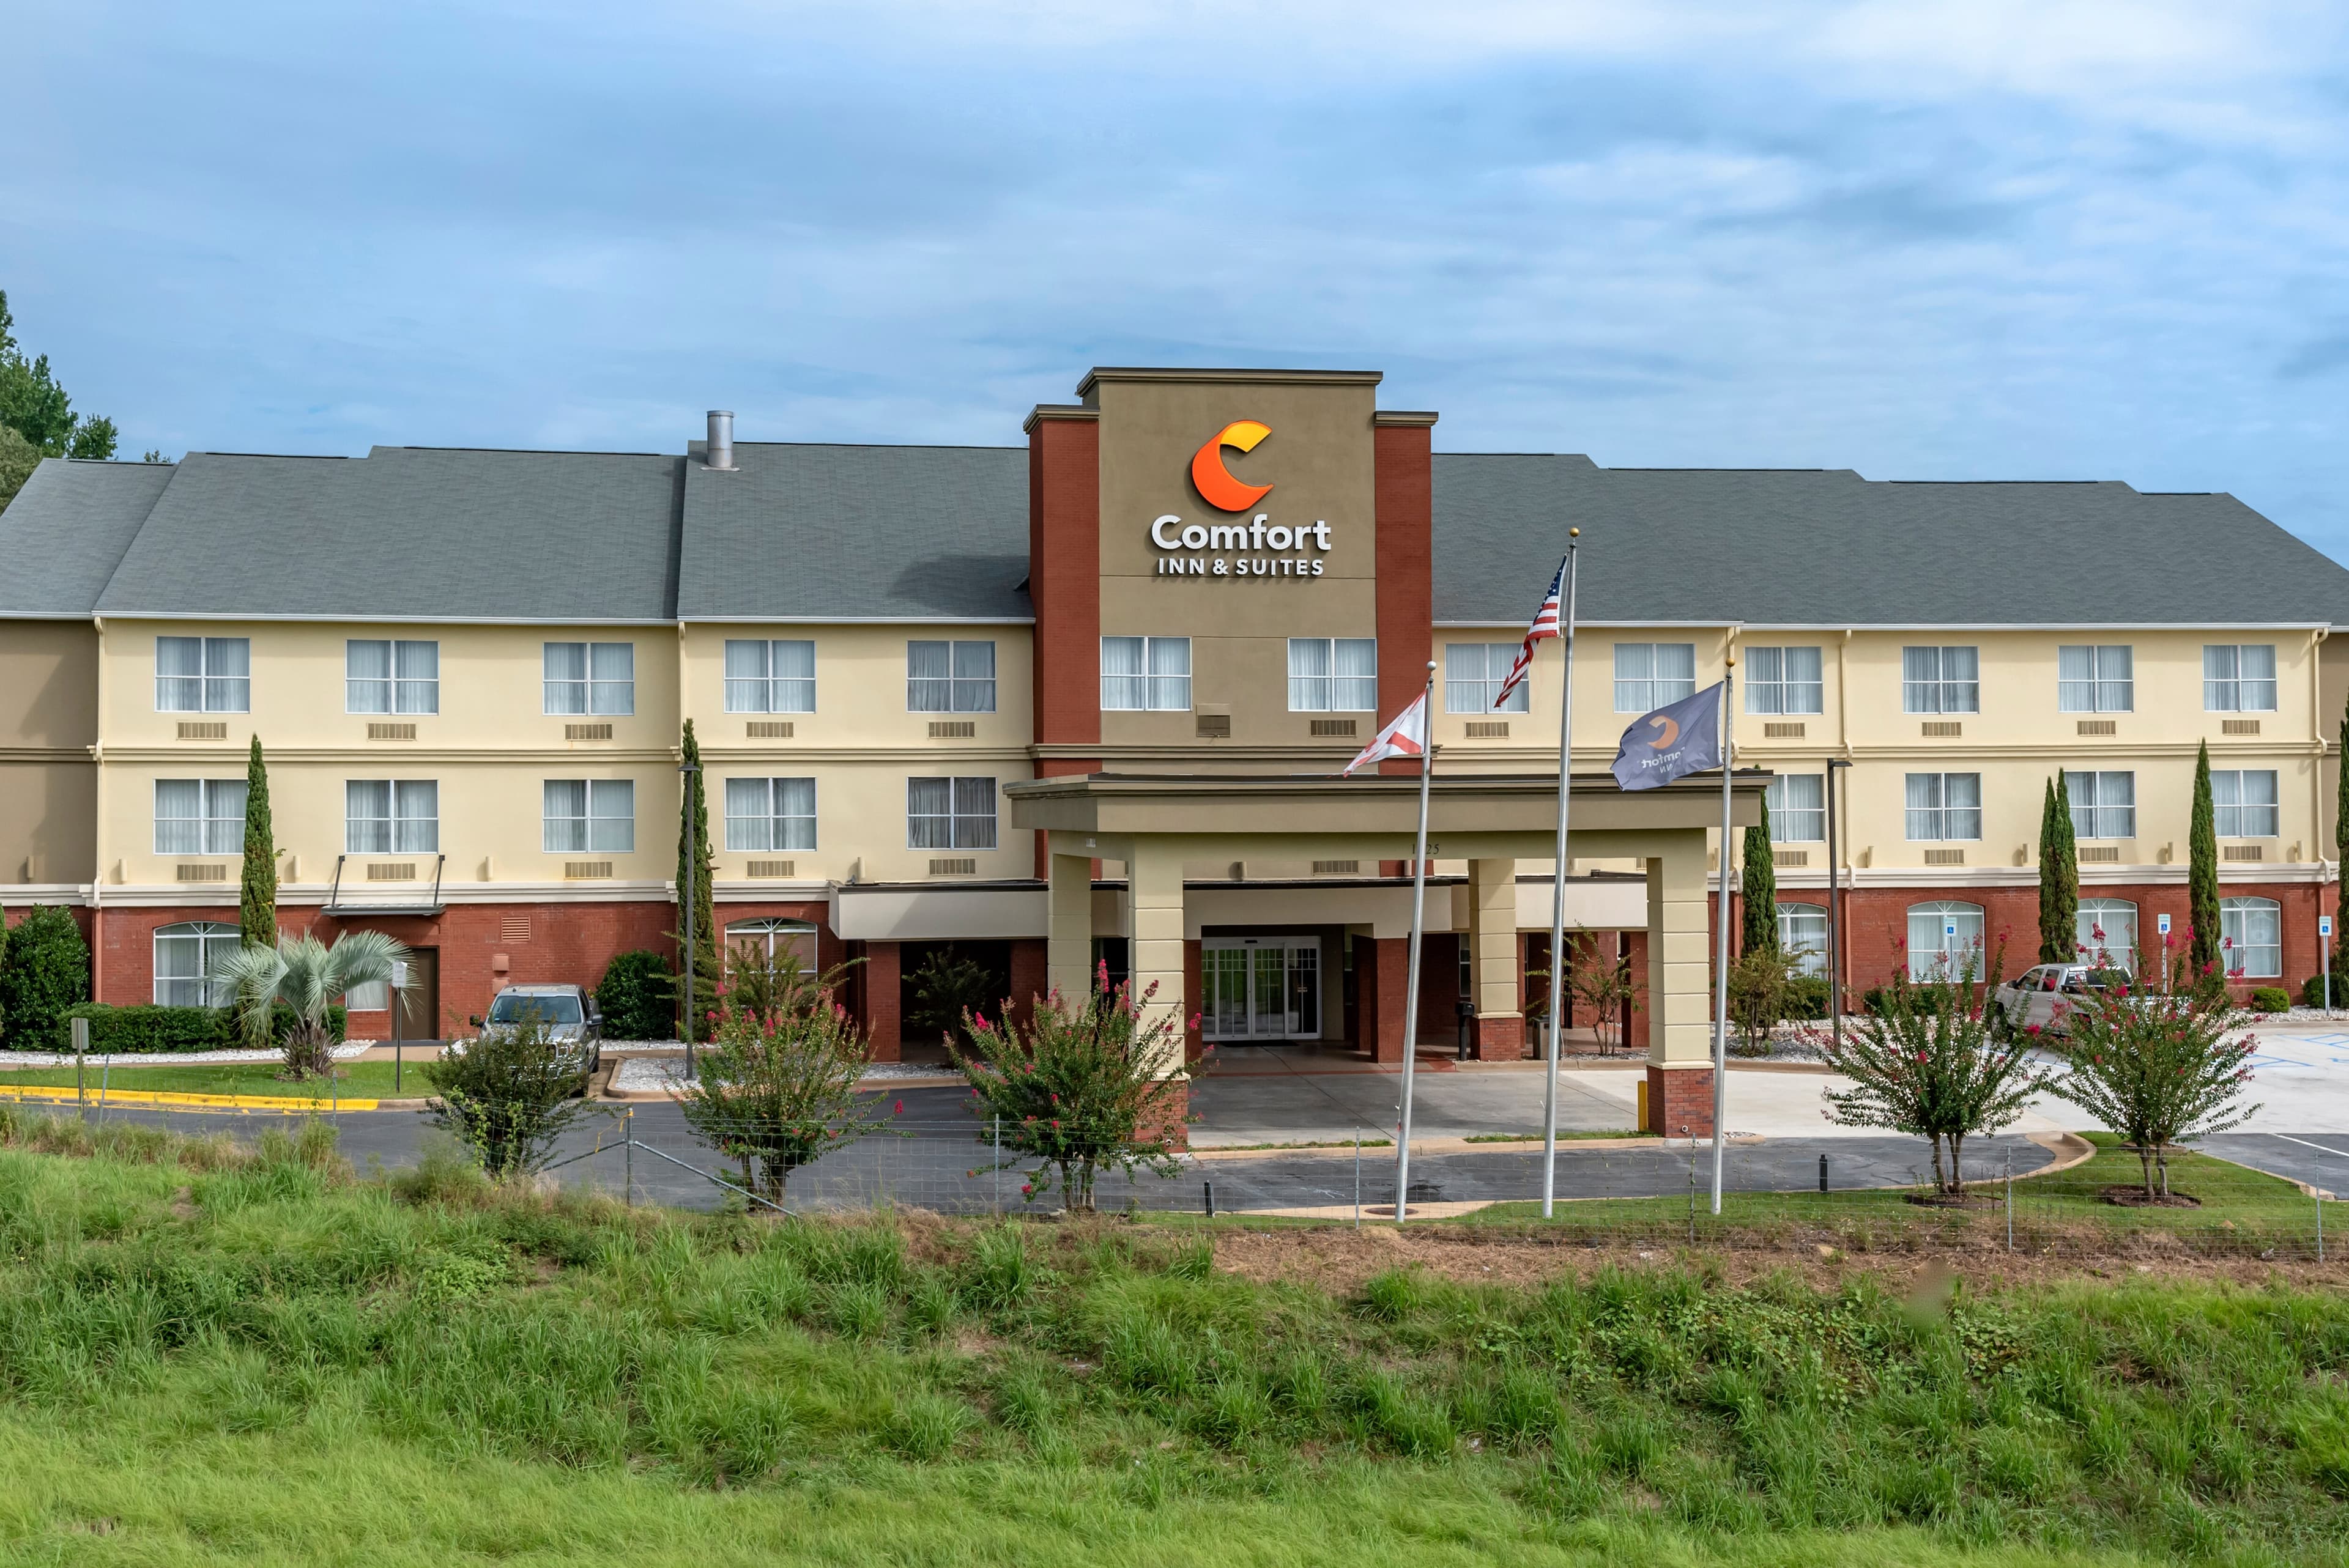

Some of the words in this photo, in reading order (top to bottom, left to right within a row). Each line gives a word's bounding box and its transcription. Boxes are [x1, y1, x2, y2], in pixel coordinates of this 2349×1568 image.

[1151, 513, 1332, 550] Comfort
[1158, 557, 1204, 575] INN
[1212, 558, 1229, 575] &
[1235, 558, 1324, 576] SUITES
[1412, 843, 1439, 855] 125
